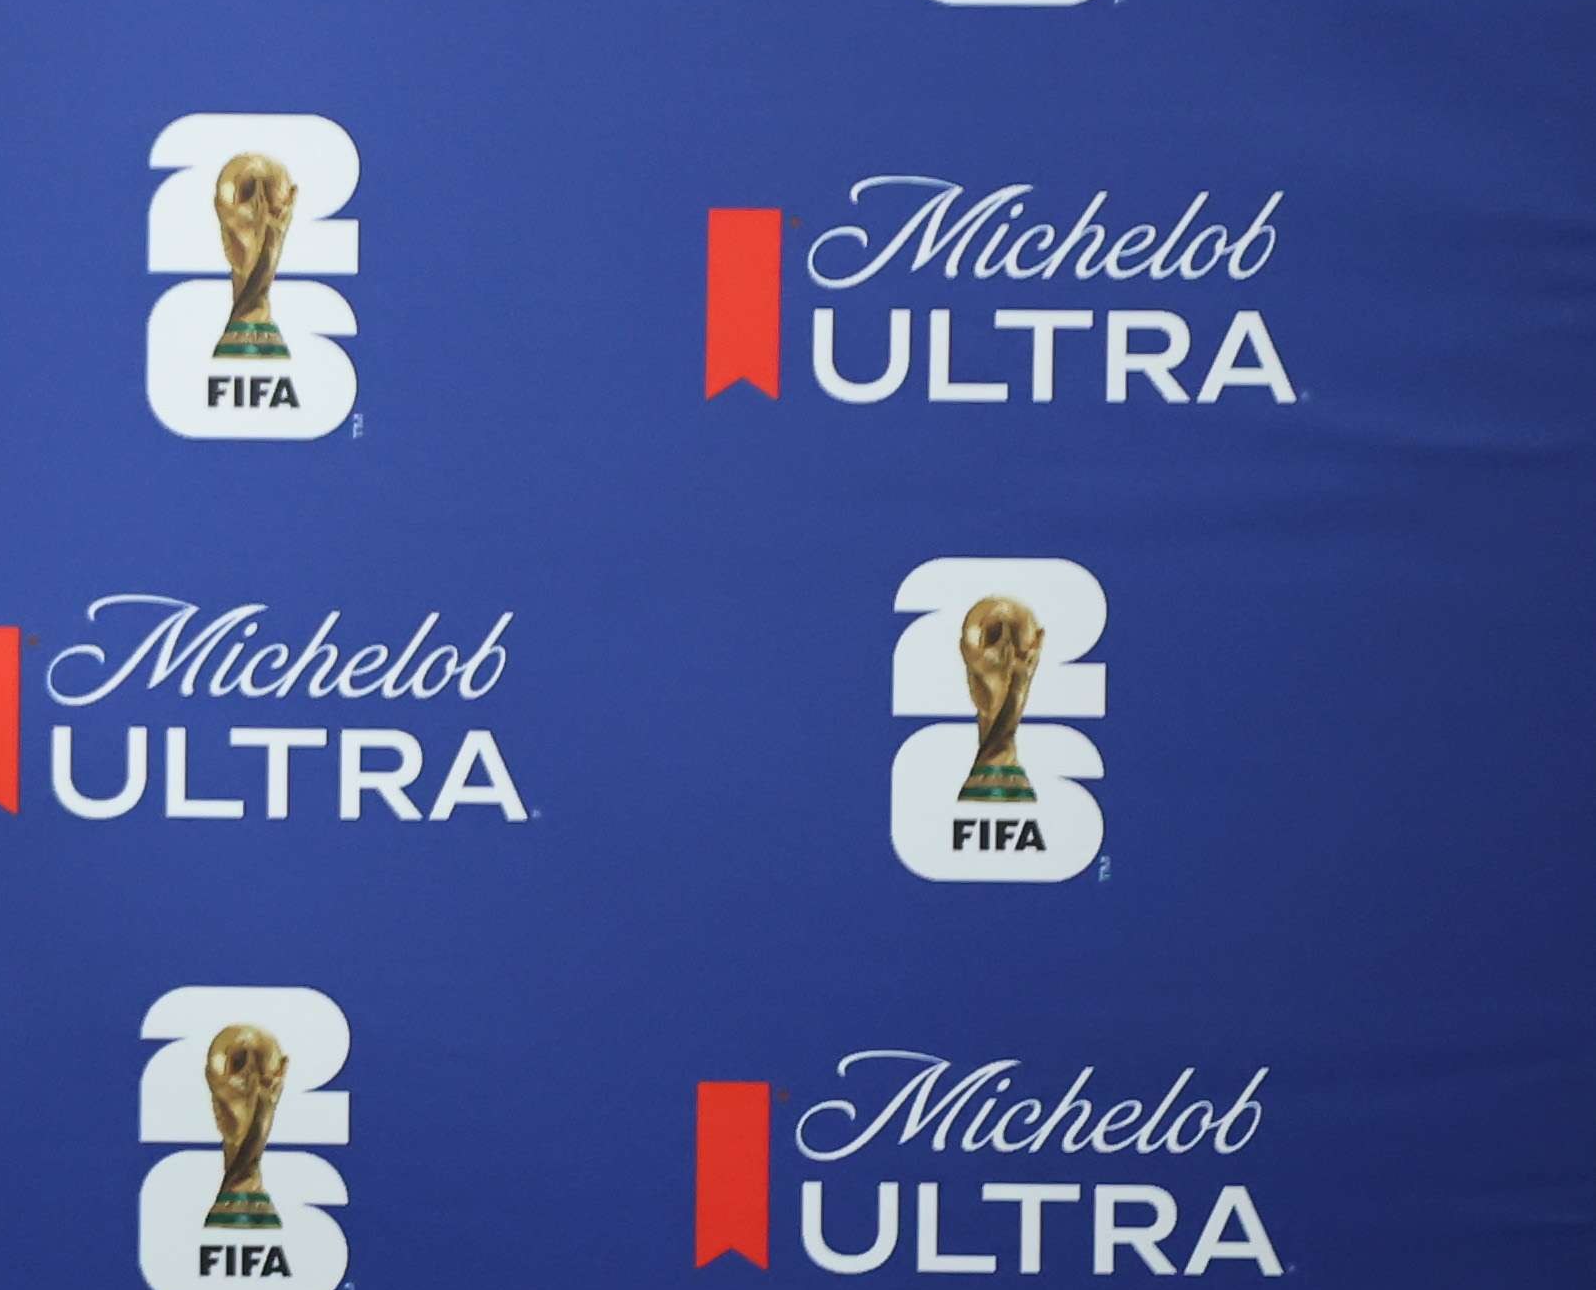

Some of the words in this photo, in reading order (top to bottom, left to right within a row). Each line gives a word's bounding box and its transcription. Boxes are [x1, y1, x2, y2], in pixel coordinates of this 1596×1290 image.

[808, 176, 1283, 288] Michelob
[209, 378, 298, 407] FIFA
[813, 309, 1296, 403] ULTRA
[47, 594, 513, 706] Michelob
[52, 726, 527, 821] ULTRA
[953, 820, 1045, 850] FIFA
[796, 1050, 1268, 1161] Michelob
[200, 1246, 290, 1277] FIFA
[802, 1181, 1283, 1276] ULTRA
